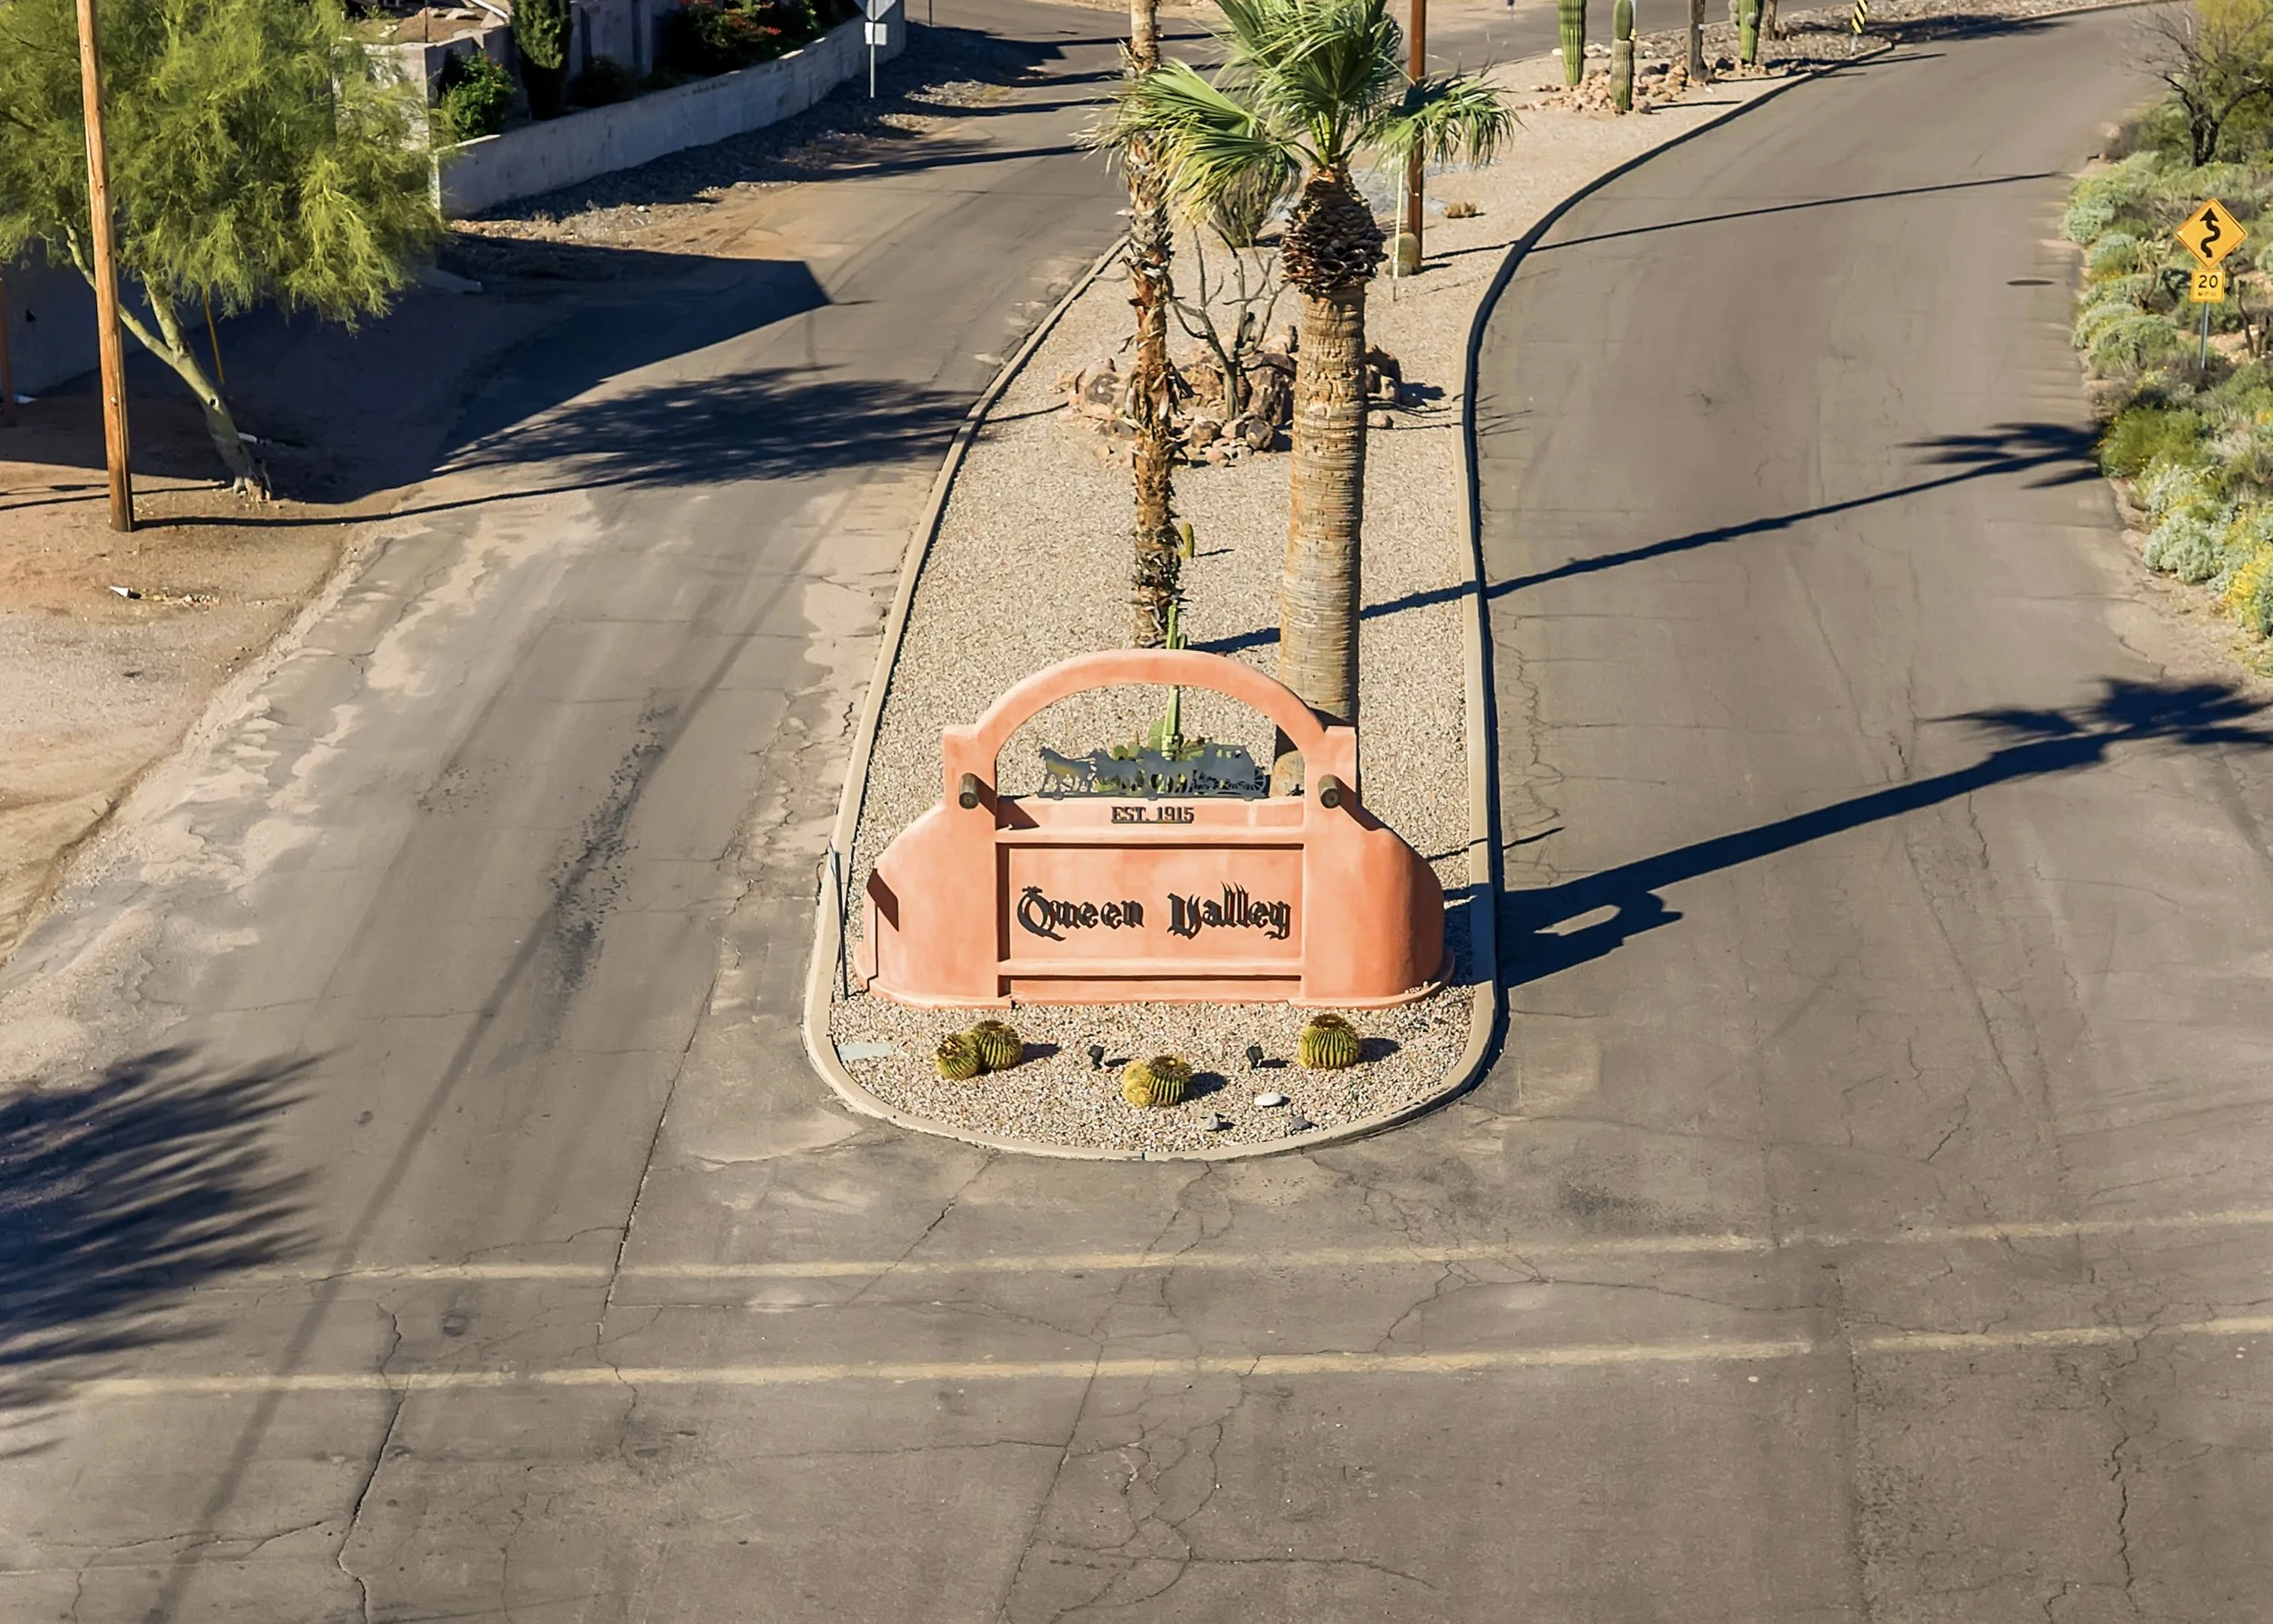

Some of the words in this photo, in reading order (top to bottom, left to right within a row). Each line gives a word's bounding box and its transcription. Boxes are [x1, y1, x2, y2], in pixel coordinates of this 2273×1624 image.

[2198, 275, 2218, 288] 20
[1111, 807, 1150, 822] EST.
[1157, 807, 1195, 822] 1915
[1017, 886, 1145, 941] Queen
[1167, 881, 1291, 939] Valley
